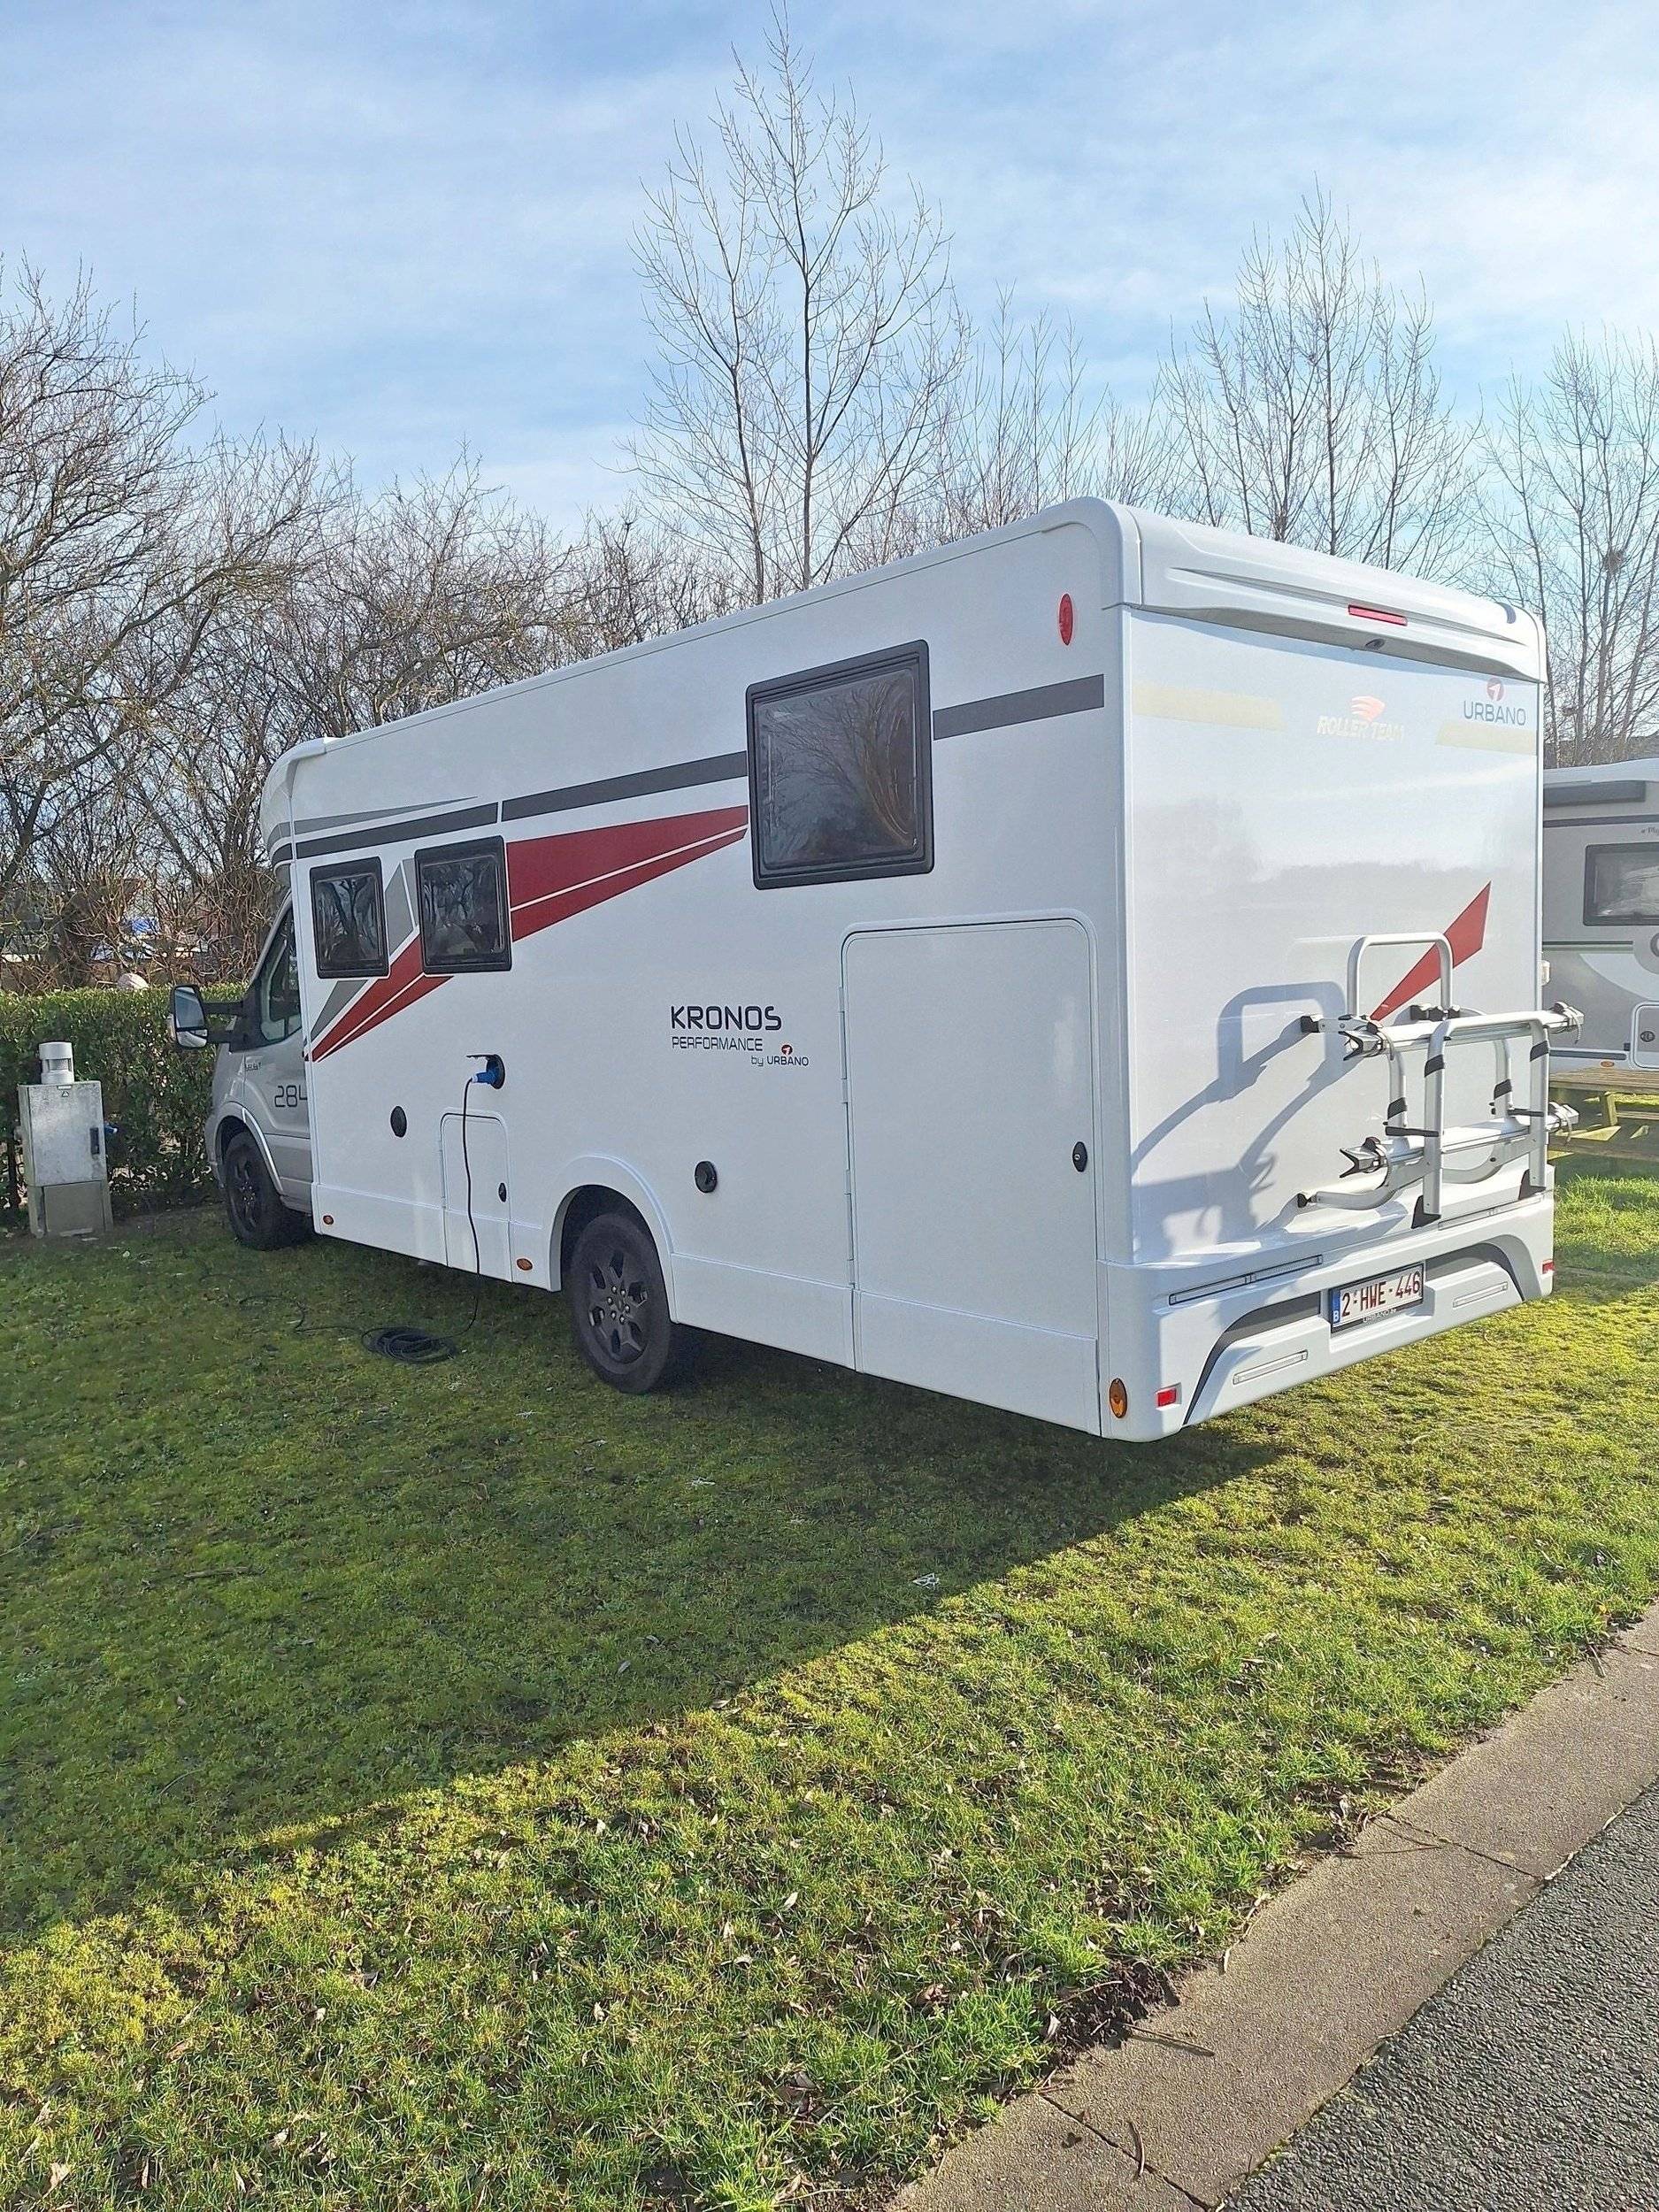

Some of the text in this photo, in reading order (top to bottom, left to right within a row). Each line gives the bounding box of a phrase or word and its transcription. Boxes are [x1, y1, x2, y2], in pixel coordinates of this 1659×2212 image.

[1463, 700, 1526, 726] URBANO
[671, 1005, 782, 1031] KRONOS
[672, 1036, 763, 1051] PERFORMANCE
[751, 1056, 809, 1066] by URBANO
[1333, 1310, 1340, 1322] B
